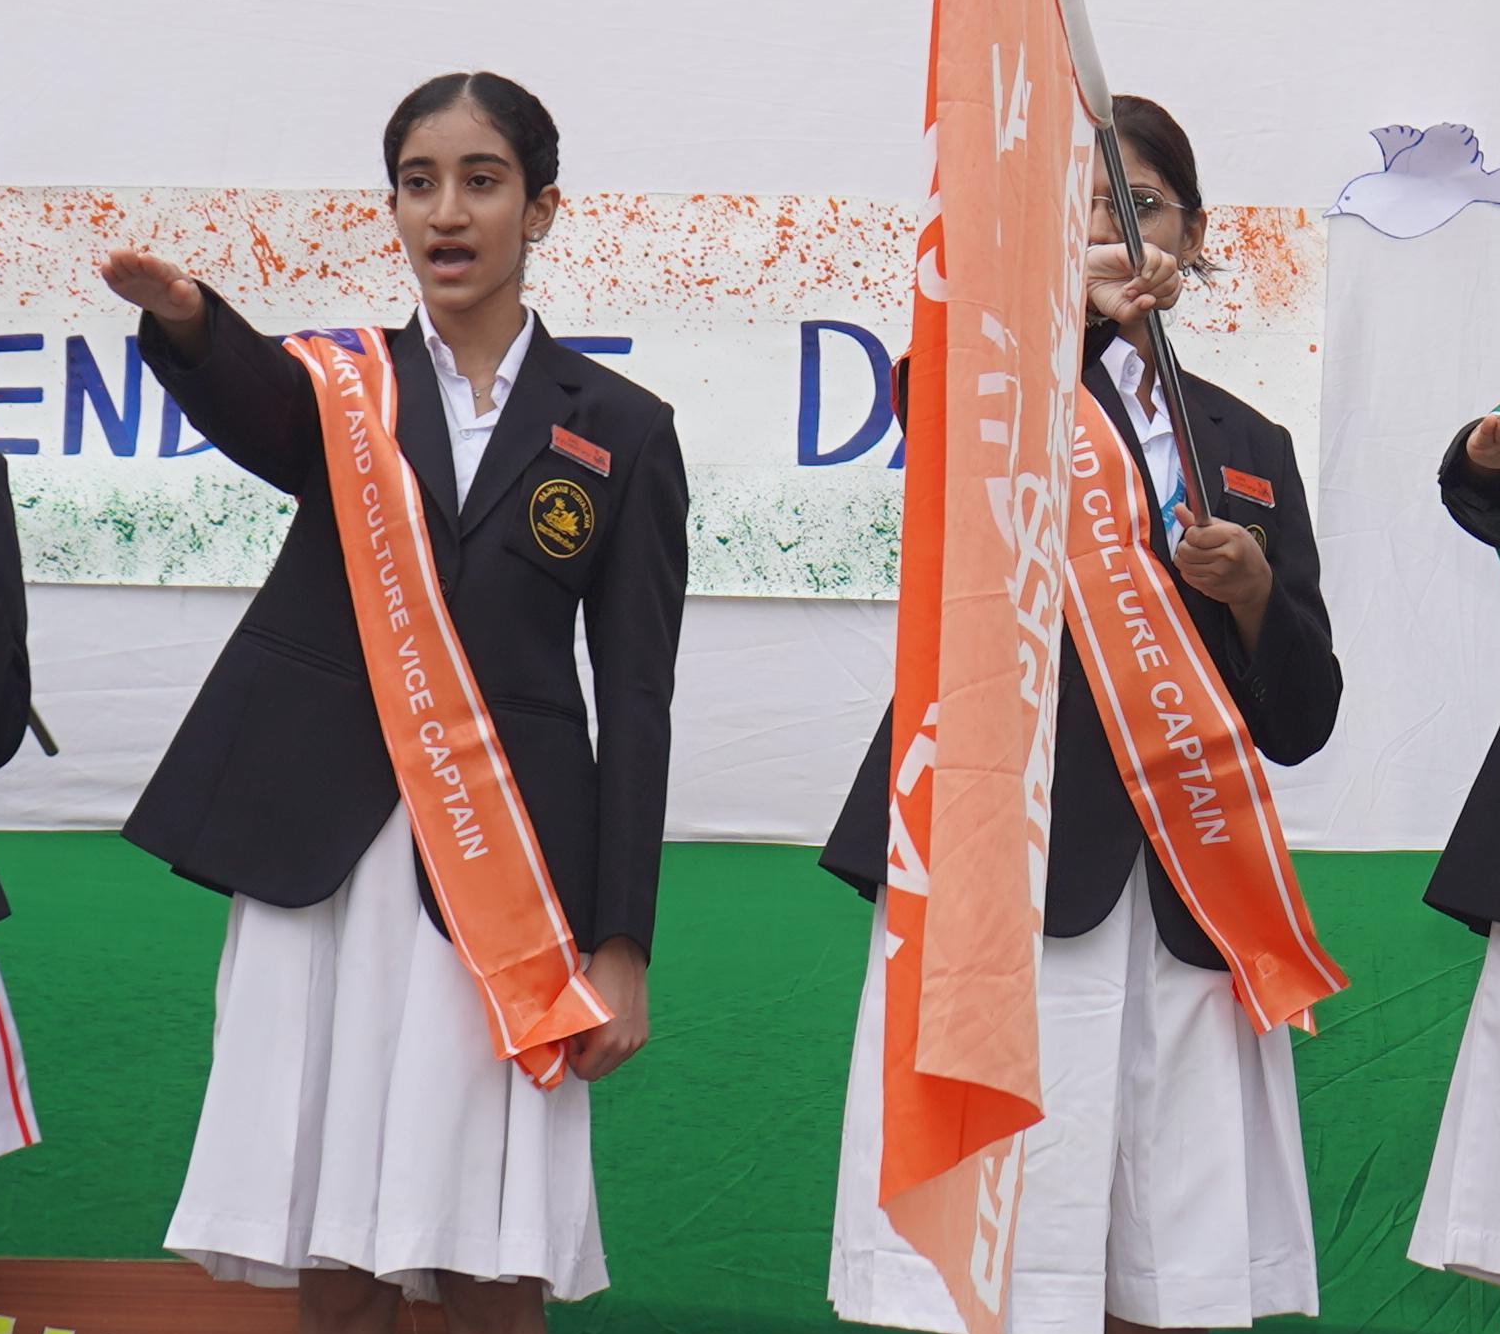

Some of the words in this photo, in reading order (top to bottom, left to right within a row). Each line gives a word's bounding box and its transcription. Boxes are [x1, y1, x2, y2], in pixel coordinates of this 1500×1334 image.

[330, 345, 364, 398] ART
[345, 410, 371, 475] AND
[1071, 425, 1099, 479] ND
[362, 482, 410, 633] CULTURE
[1082, 489, 1169, 673] CULTURE
[397, 637, 434, 715] VICE
[419, 720, 488, 861] CAPTAIN
[1150, 680, 1230, 847] CAPTAIN
